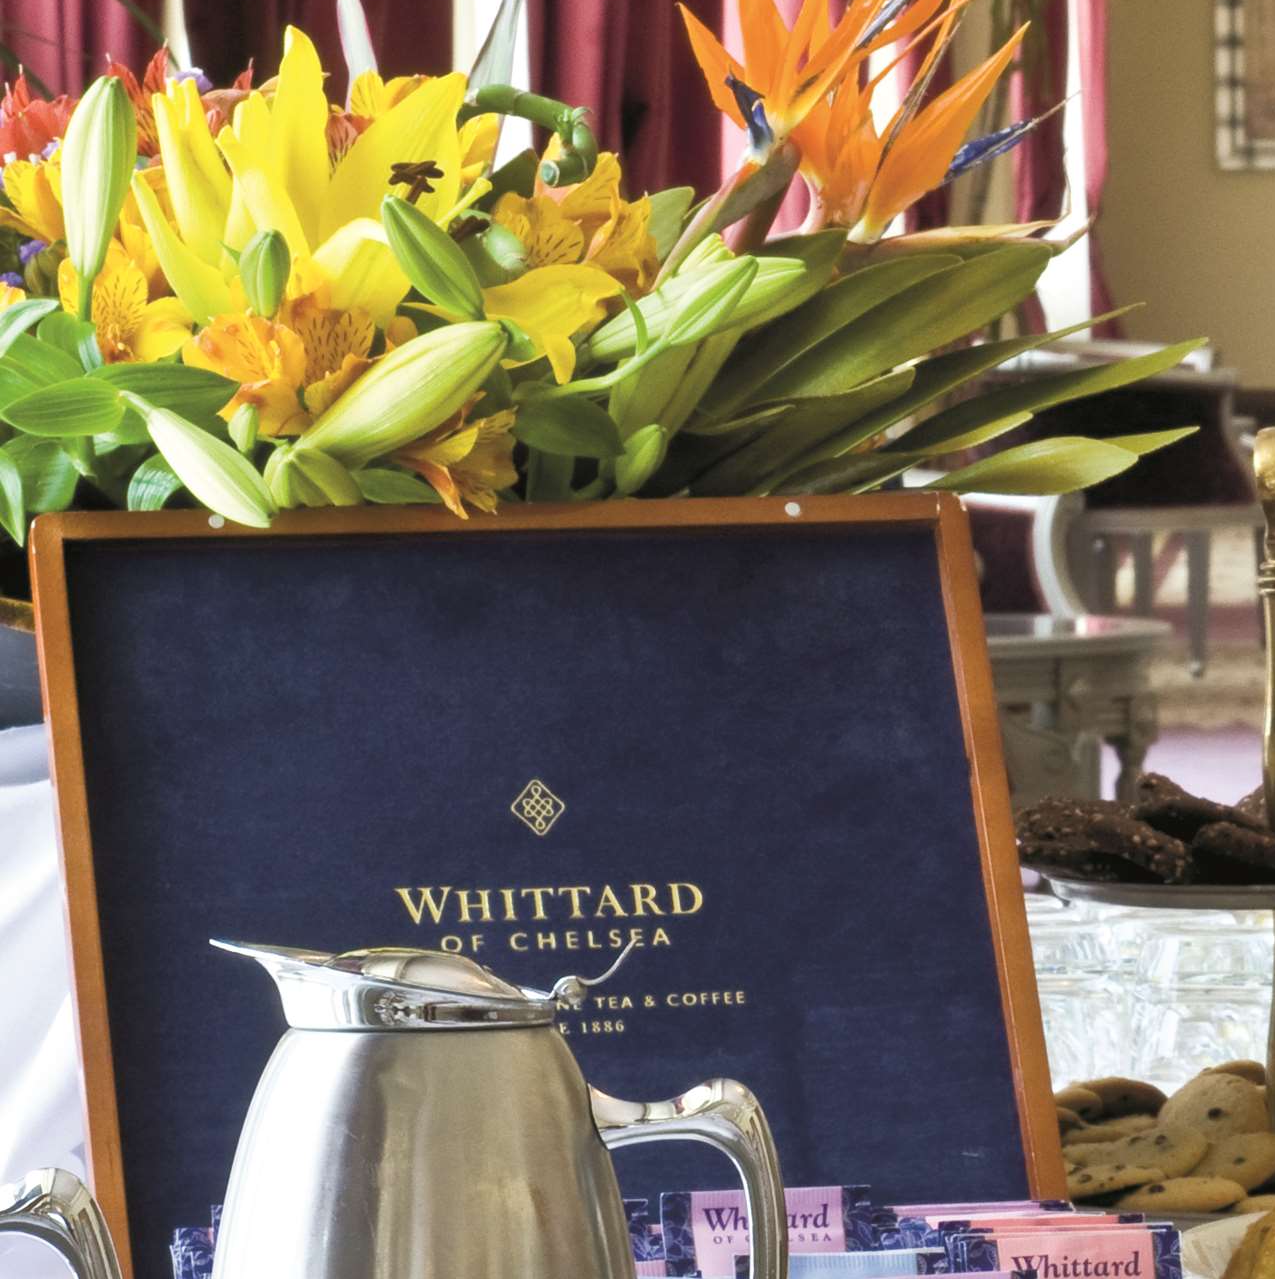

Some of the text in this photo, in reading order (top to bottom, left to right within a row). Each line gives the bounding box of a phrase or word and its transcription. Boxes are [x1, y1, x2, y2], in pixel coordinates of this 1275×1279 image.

[394, 883, 704, 925] WHITTARD
[441, 928, 671, 953] OF CHELSEA
[595, 996, 633, 1010] TEA
[644, 995, 656, 1008] &
[666, 991, 746, 1008] COFFEE
[581, 1019, 625, 1034] 1886
[1011, 1250, 1142, 1279] Whittard
